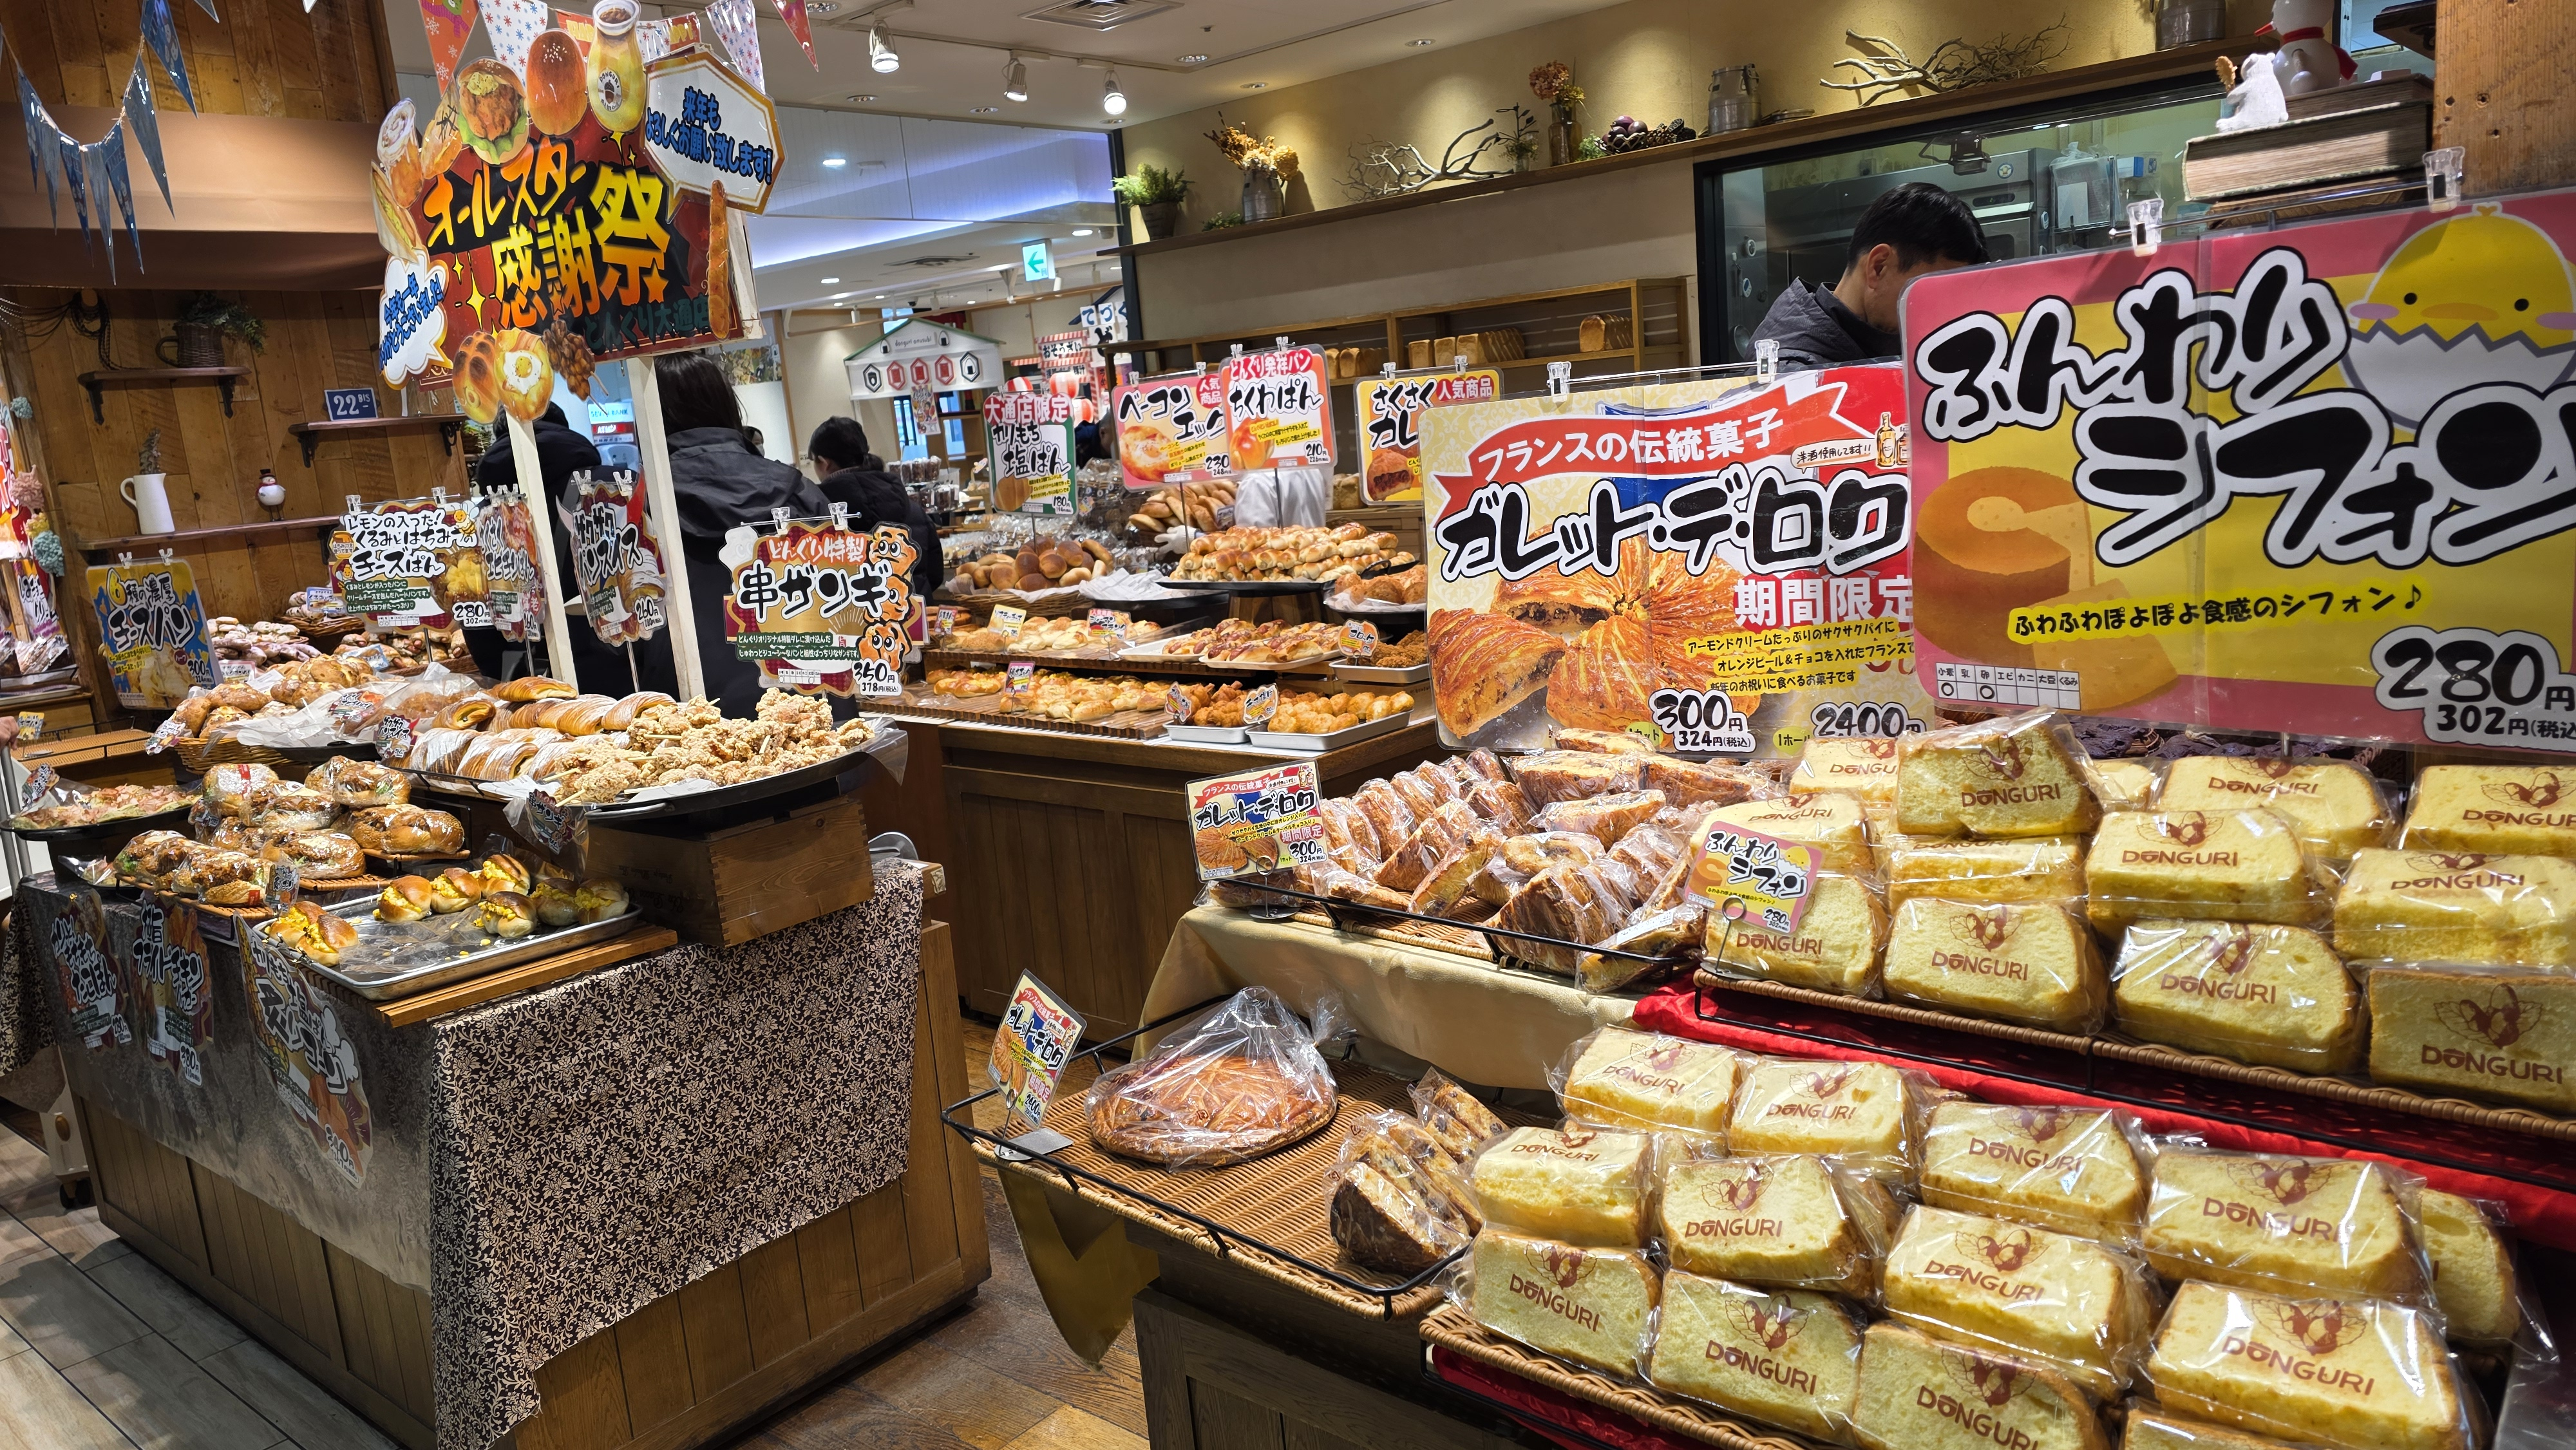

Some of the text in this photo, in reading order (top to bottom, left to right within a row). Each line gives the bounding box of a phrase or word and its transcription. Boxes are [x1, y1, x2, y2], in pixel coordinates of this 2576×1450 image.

[682, 86, 721, 131] 来年も
[424, 137, 587, 247] オールスター
[491, 164, 670, 328] 感謝祭
[384, 271, 419, 329] 今年も一年
[1924, 263, 2333, 425] ふんわり
[1231, 351, 1311, 381] どんぐり発祥パン
[1199, 377, 1220, 391] 人気
[1200, 391, 1222, 405] 商品
[1229, 377, 1321, 418] ちくわぱん
[1373, 381, 1435, 411] さくさく
[1438, 377, 1493, 401] 人気商品
[333, 393, 370, 416] 22 BIS
[985, 395, 1069, 426] 大通店限定
[1119, 387, 1191, 420] ベーコン
[1003, 444, 1070, 476] 塩ぱん
[1305, 443, 1327, 457] 210円
[1477, 408, 1783, 483] フランスの伝統菓子
[348, 513, 441, 531] レモンの入った!
[355, 547, 442, 577] チーズぱん
[768, 534, 865, 563] どんぐり特製
[108, 569, 174, 607] 6種の濃厚
[740, 562, 890, 619] 串ザンギ
[1734, 578, 1912, 626] 期間限定
[454, 605, 490, 617] 280円
[1688, 620, 1895, 653] アーモンドクリームたっぷりのサクサクパイに
[853, 663, 895, 684] 350円
[1710, 670, 1856, 692] 新年のお祝いに食べるお菓子です
[1980, 670, 1990, 680] 卵
[1997, 672, 2014, 681] エビ
[2018, 674, 2035, 683] カニ
[2038, 675, 2056, 684] 大豆
[2059, 677, 2078, 686] くるみ
[2384, 637, 2575, 712] 280円
[1654, 693, 1743, 731] 300円
[1678, 730, 1751, 748] 324円(税込)
[1204, 775, 1271, 797] フランスの伝統菓子
[1961, 782, 2061, 809] DONGURI
[2208, 776, 2318, 795] DONGURI
[1749, 807, 1833, 823] DONGURI
[1281, 824, 1323, 843] 期間限定
[1707, 833, 1777, 863] ふんわり
[1289, 840, 1322, 858] 300円
[2121, 849, 2239, 867] DONGURI
[1730, 856, 1804, 896] シフォン
[2391, 872, 2526, 890] DONGURI
[1765, 909, 1789, 927] 280円
[1736, 932, 1823, 956] DONGURI
[1931, 951, 2029, 981] DONGURI
[2160, 973, 2277, 1004] DONGURI
[1602, 1064, 1685, 1094] DONGURI
[2421, 1044, 2564, 1084] DONGURI
[1765, 1102, 1857, 1120] DONGURI
[1511, 1143, 1600, 1162] DONGURI
[1969, 1137, 2083, 1173] DONGURI
[1685, 1218, 1783, 1238] DONGURI
[1924, 1259, 2045, 1303] DONGURI
[1510, 1274, 1600, 1333] DONGURI
[1705, 1340, 1818, 1397] DONGURI
[2221, 1335, 2374, 1397] DONGURI
